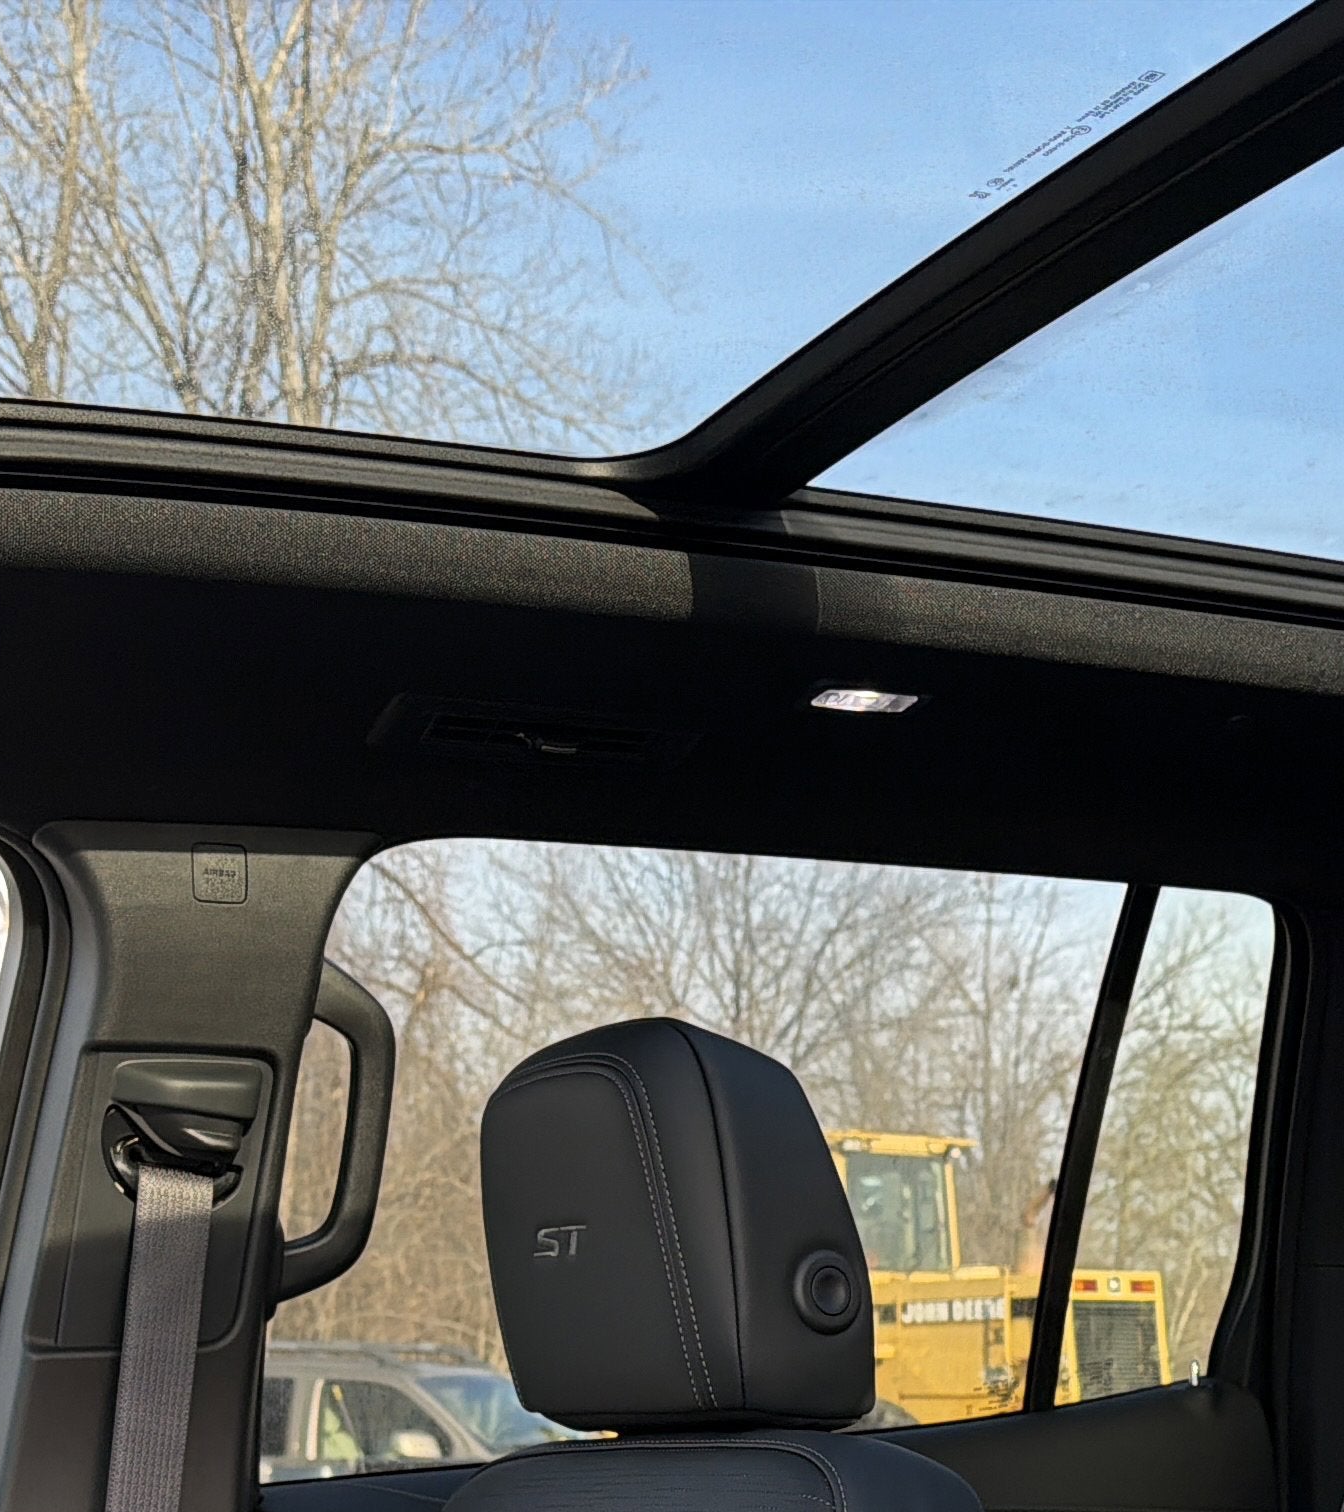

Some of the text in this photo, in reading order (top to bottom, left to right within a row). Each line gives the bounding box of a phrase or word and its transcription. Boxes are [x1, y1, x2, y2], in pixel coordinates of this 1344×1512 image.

[533, 1225, 586, 1257] ST
[902, 1297, 1004, 1324] JOHN DEERE
